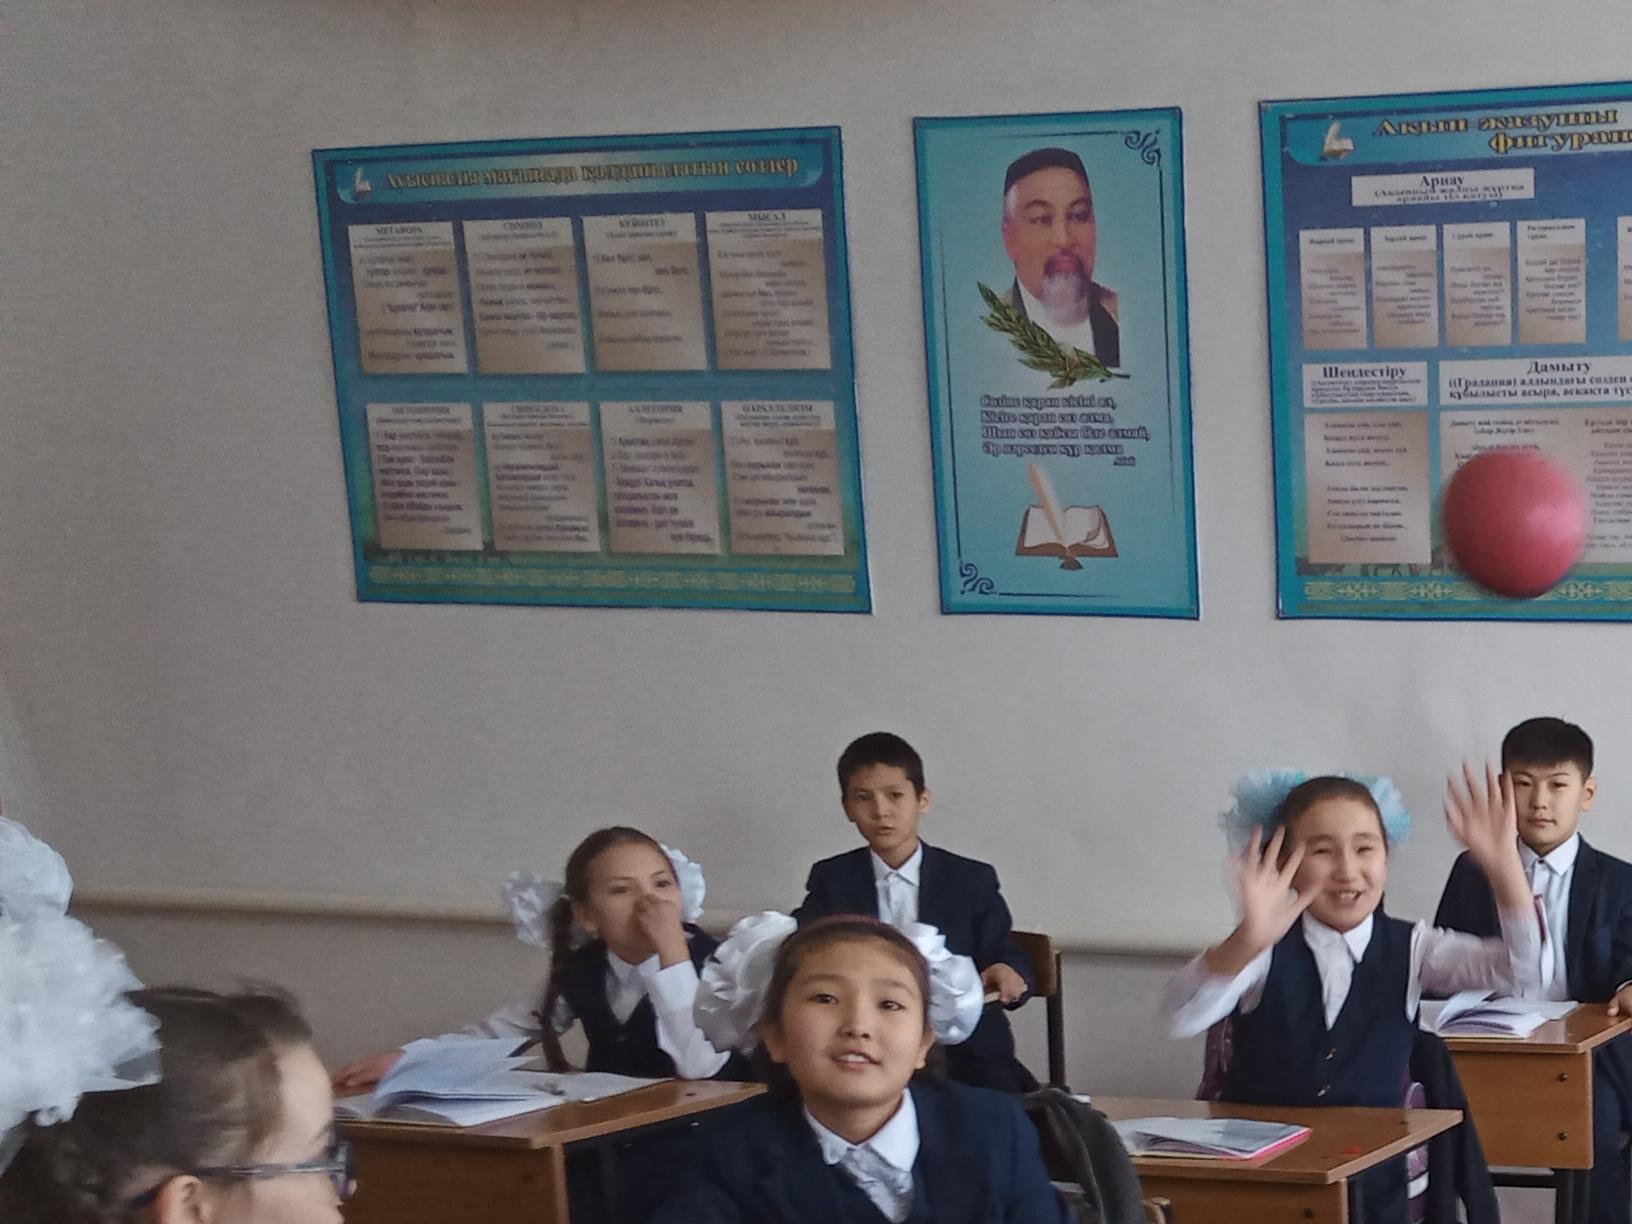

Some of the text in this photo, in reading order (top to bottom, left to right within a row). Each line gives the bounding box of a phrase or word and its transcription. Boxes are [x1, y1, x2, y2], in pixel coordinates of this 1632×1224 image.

[1419, 174, 1465, 192] Арнау
[1321, 364, 1407, 381] Шендестіру
[1526, 359, 1593, 375] Дамыту
